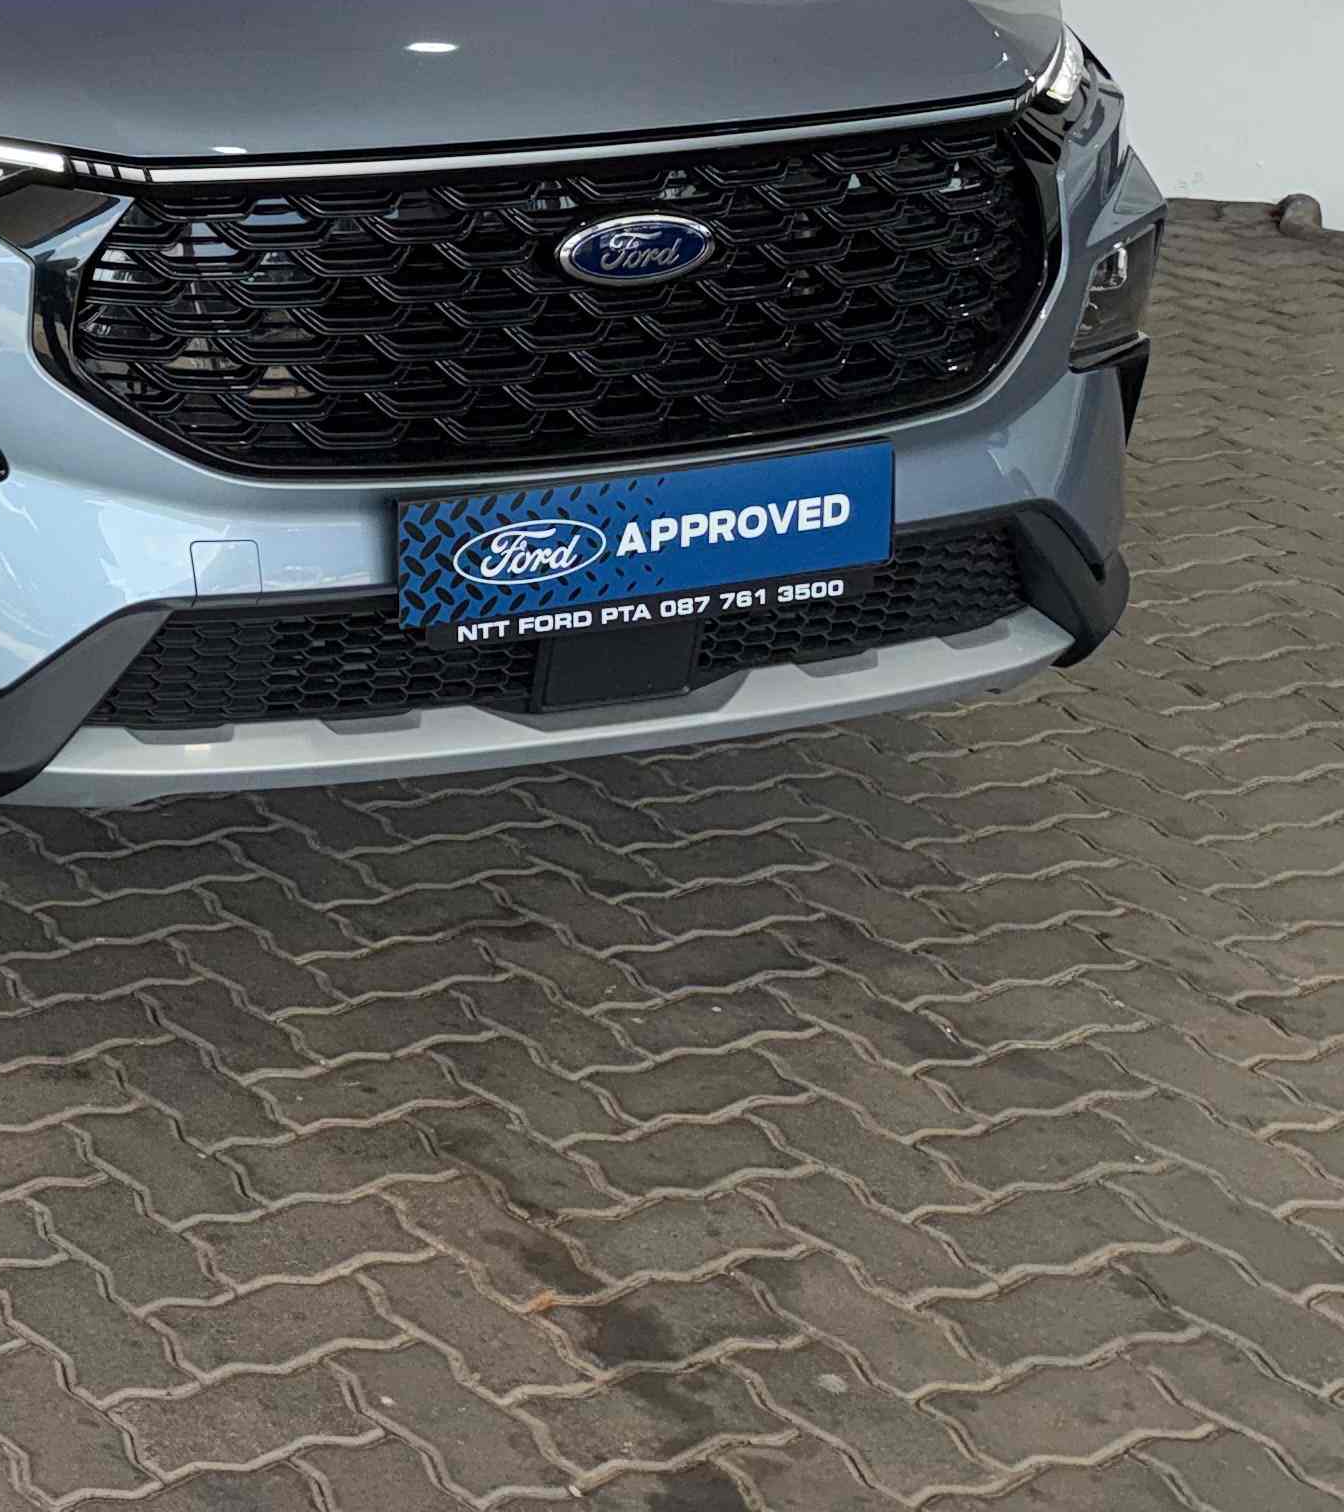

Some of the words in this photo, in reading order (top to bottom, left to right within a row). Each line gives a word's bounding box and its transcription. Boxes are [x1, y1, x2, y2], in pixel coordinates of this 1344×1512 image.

[600, 230, 682, 271] Ford
[480, 527, 581, 578] Ford
[616, 493, 850, 557] APPROVED
[457, 619, 510, 643] NTT
[518, 610, 593, 635] FORD
[601, 603, 652, 625] PTA
[660, 595, 711, 618] 087
[719, 588, 766, 610] 761
[777, 579, 844, 603] 3500
